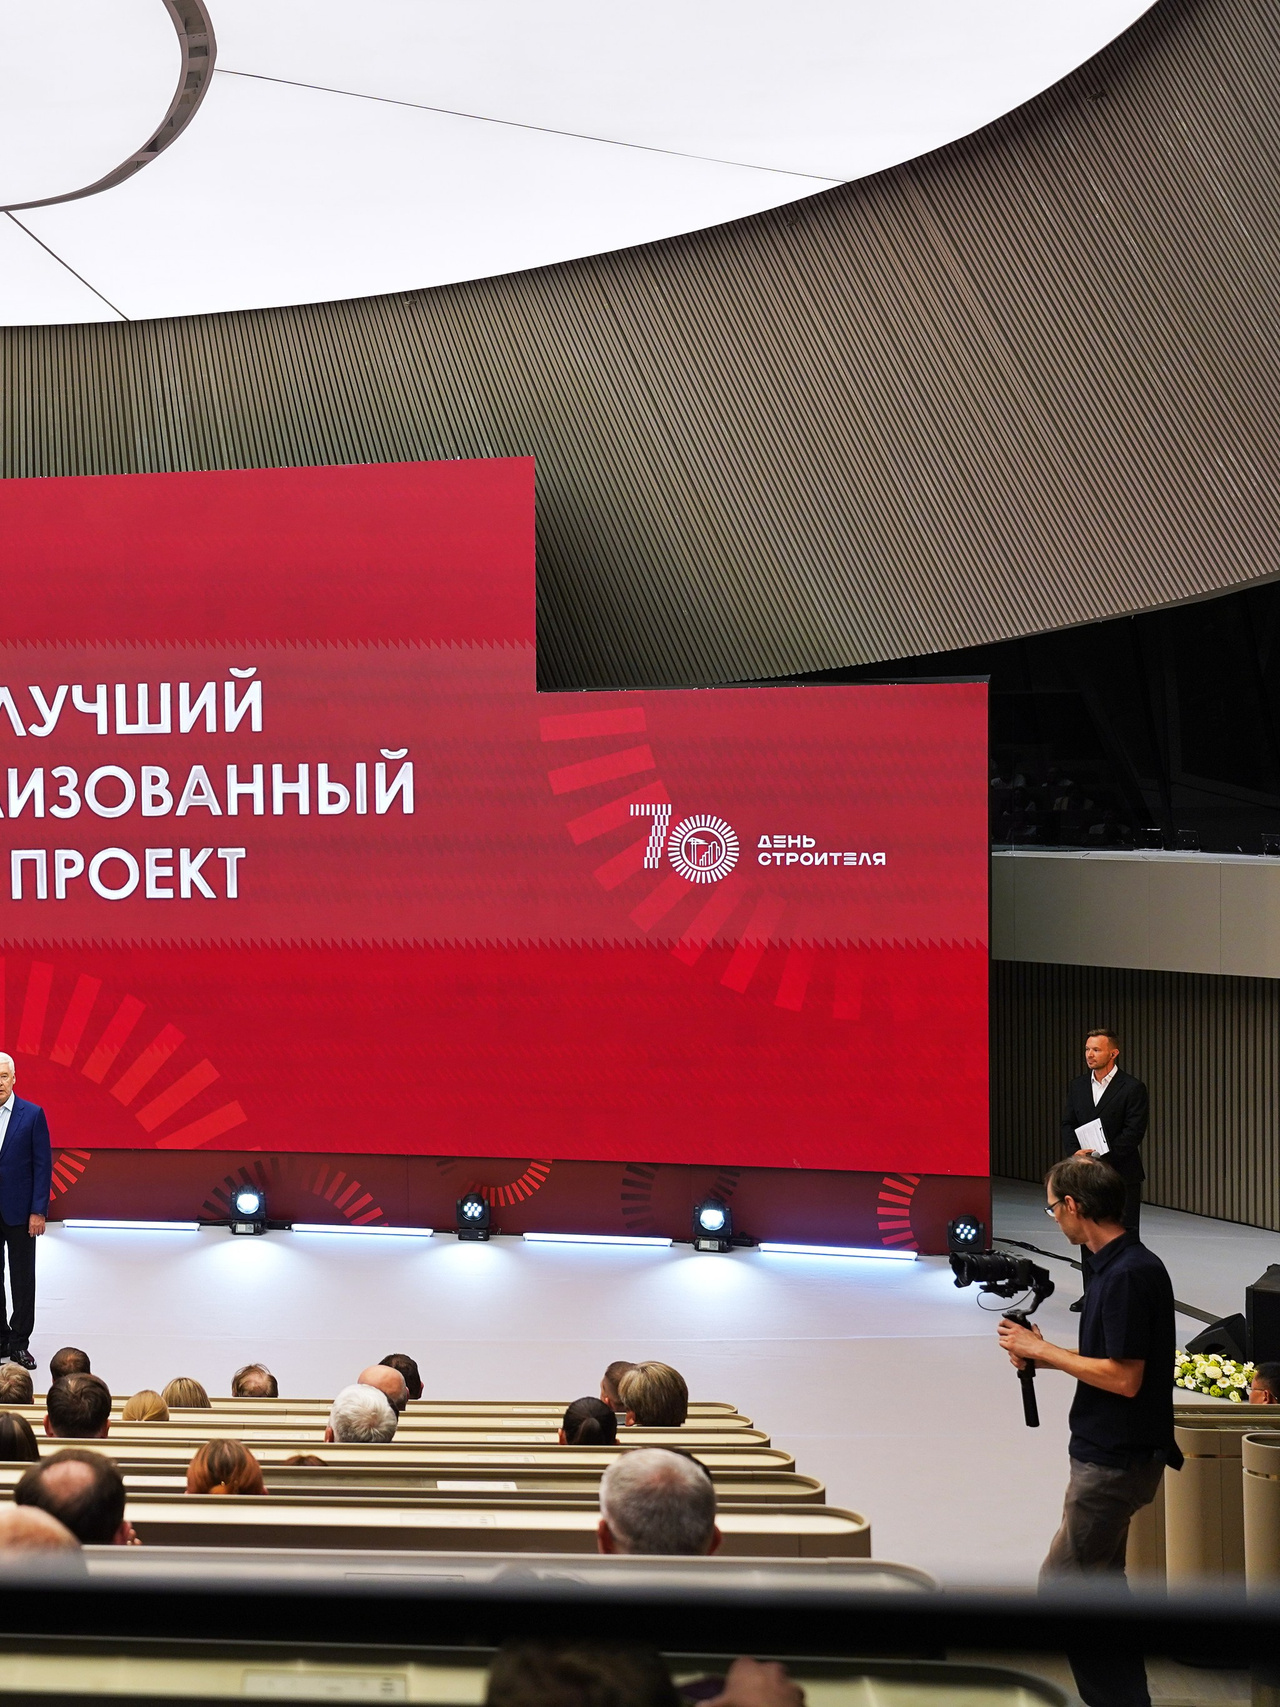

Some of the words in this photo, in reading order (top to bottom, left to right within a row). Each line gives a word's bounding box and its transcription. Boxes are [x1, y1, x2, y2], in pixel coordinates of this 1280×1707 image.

[757, 834, 816, 849] ДЕНЬ
[757, 852, 886, 866] СТРОИТЕЛЯ
[10, 847, 246, 901] ПРОЕКТ
